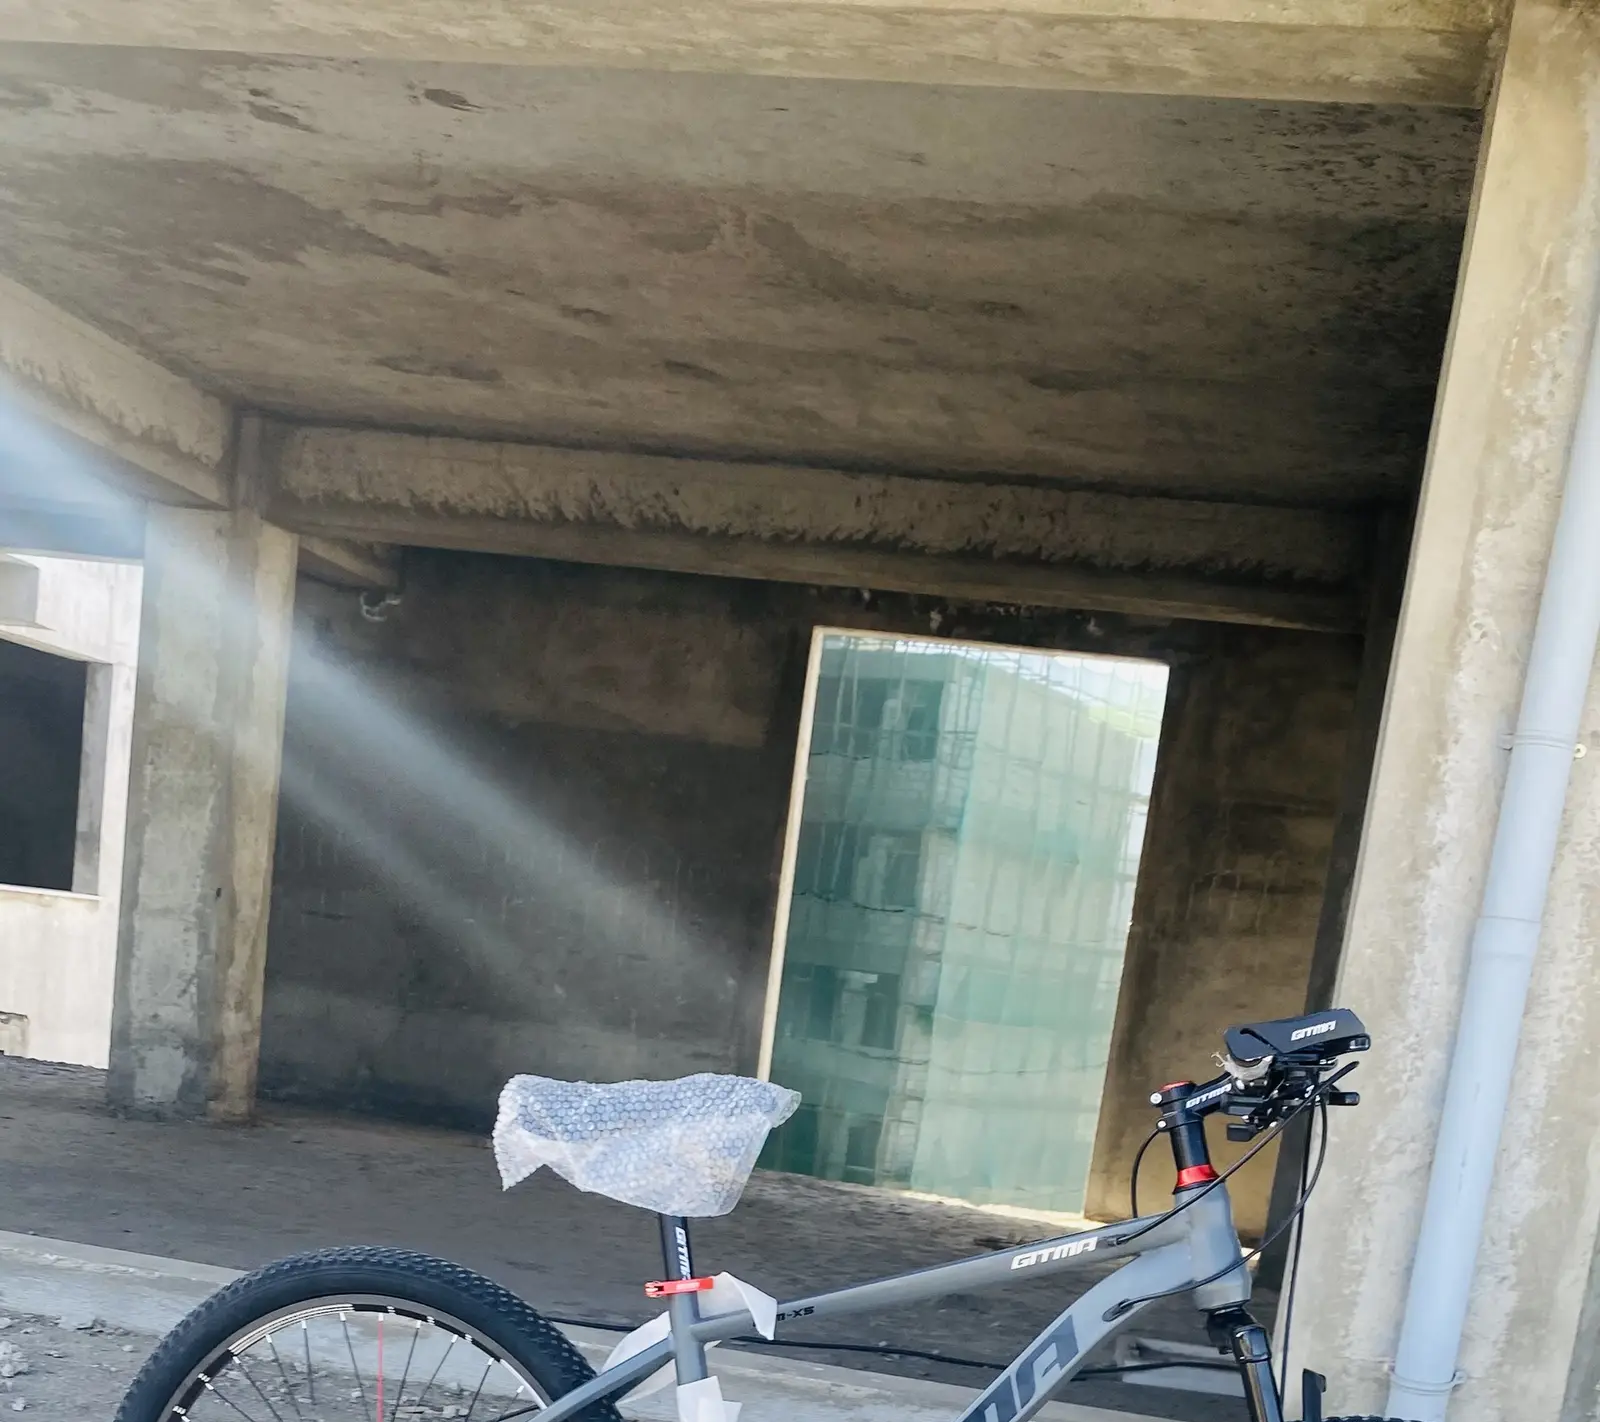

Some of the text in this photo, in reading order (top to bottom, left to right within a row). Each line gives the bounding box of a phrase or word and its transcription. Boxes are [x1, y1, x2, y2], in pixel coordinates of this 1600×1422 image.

[1291, 1020, 1336, 1041] GITMA
[1185, 1083, 1232, 1109] GITMA
[1010, 1236, 1098, 1270] GITMA
